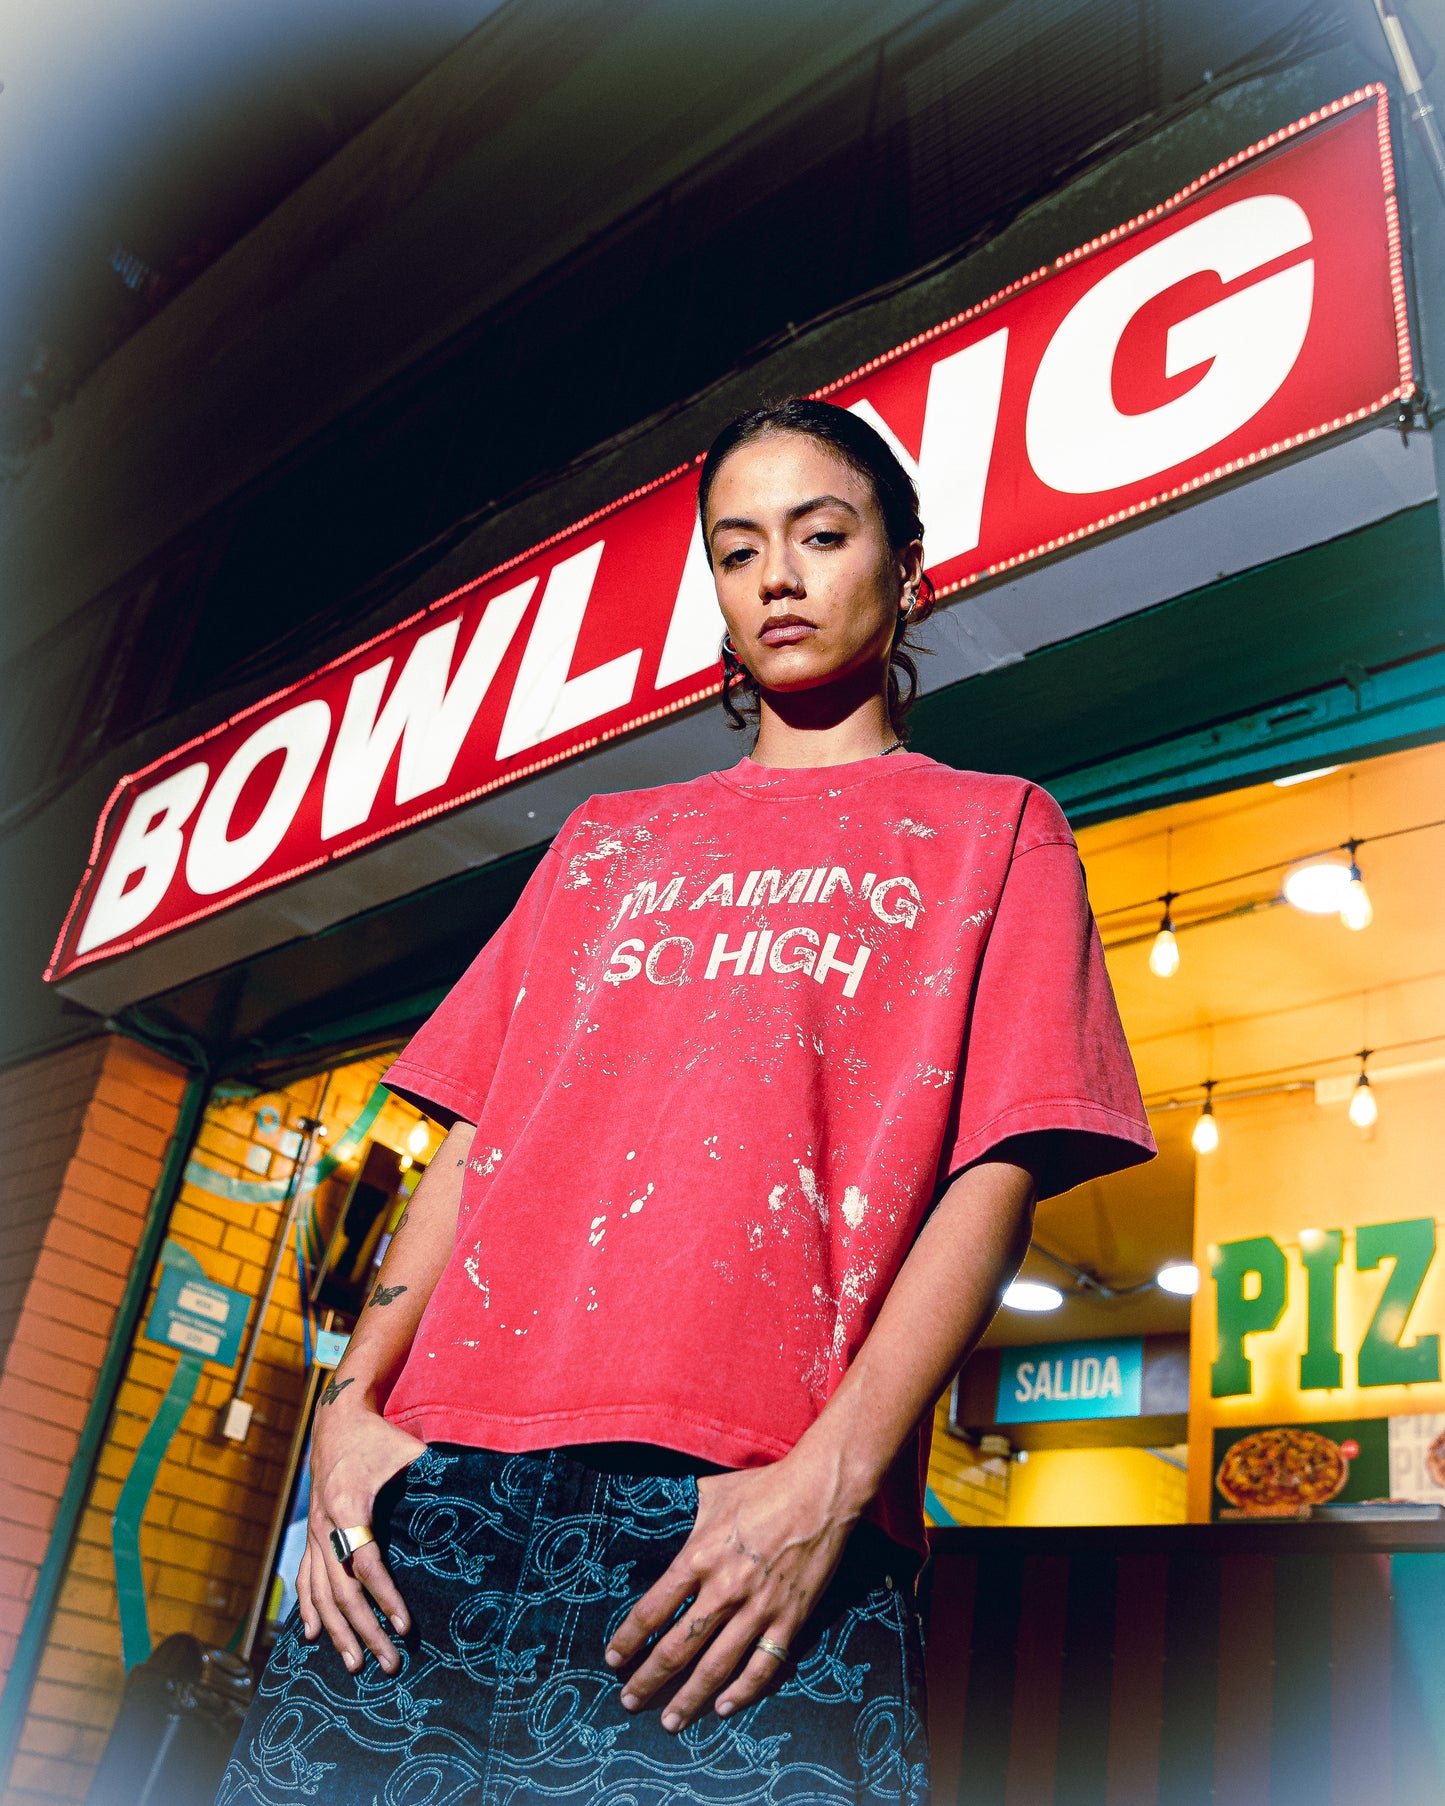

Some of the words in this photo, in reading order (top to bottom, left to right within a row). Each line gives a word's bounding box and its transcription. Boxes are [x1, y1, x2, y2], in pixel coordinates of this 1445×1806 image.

[688, 866, 922, 930] AIMING
[603, 936, 695, 986] SO
[704, 926, 873, 998] HIGH
[1211, 1217, 1442, 1398] PIZ
[1015, 1356, 1122, 1402] SALIDA
